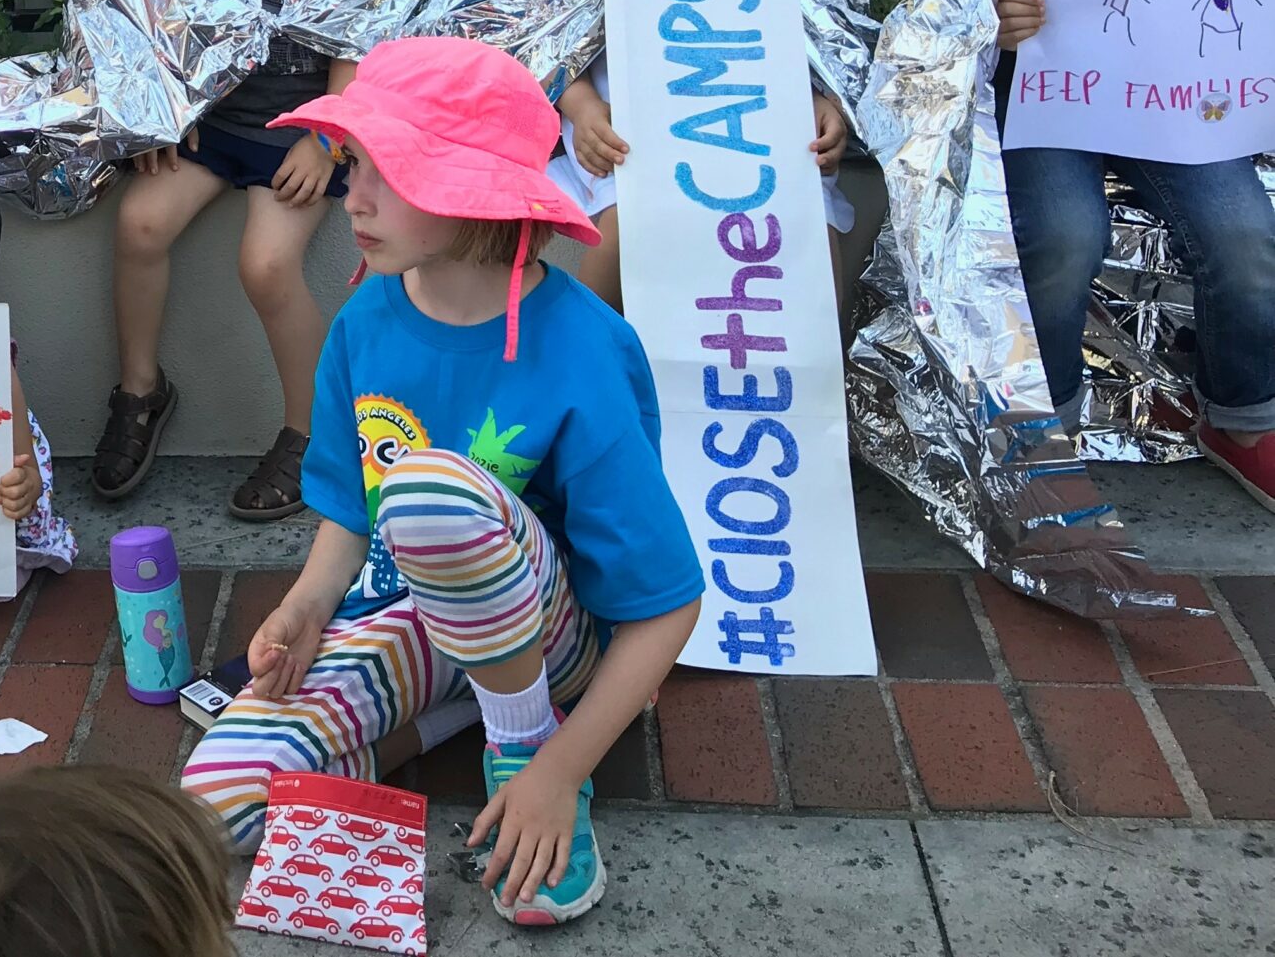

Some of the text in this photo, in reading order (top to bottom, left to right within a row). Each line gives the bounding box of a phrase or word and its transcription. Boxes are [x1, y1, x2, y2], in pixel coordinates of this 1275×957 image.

[1020, 70, 1275, 111] KEEP FAMILIES
[370, 407, 416, 441] ANGELES
